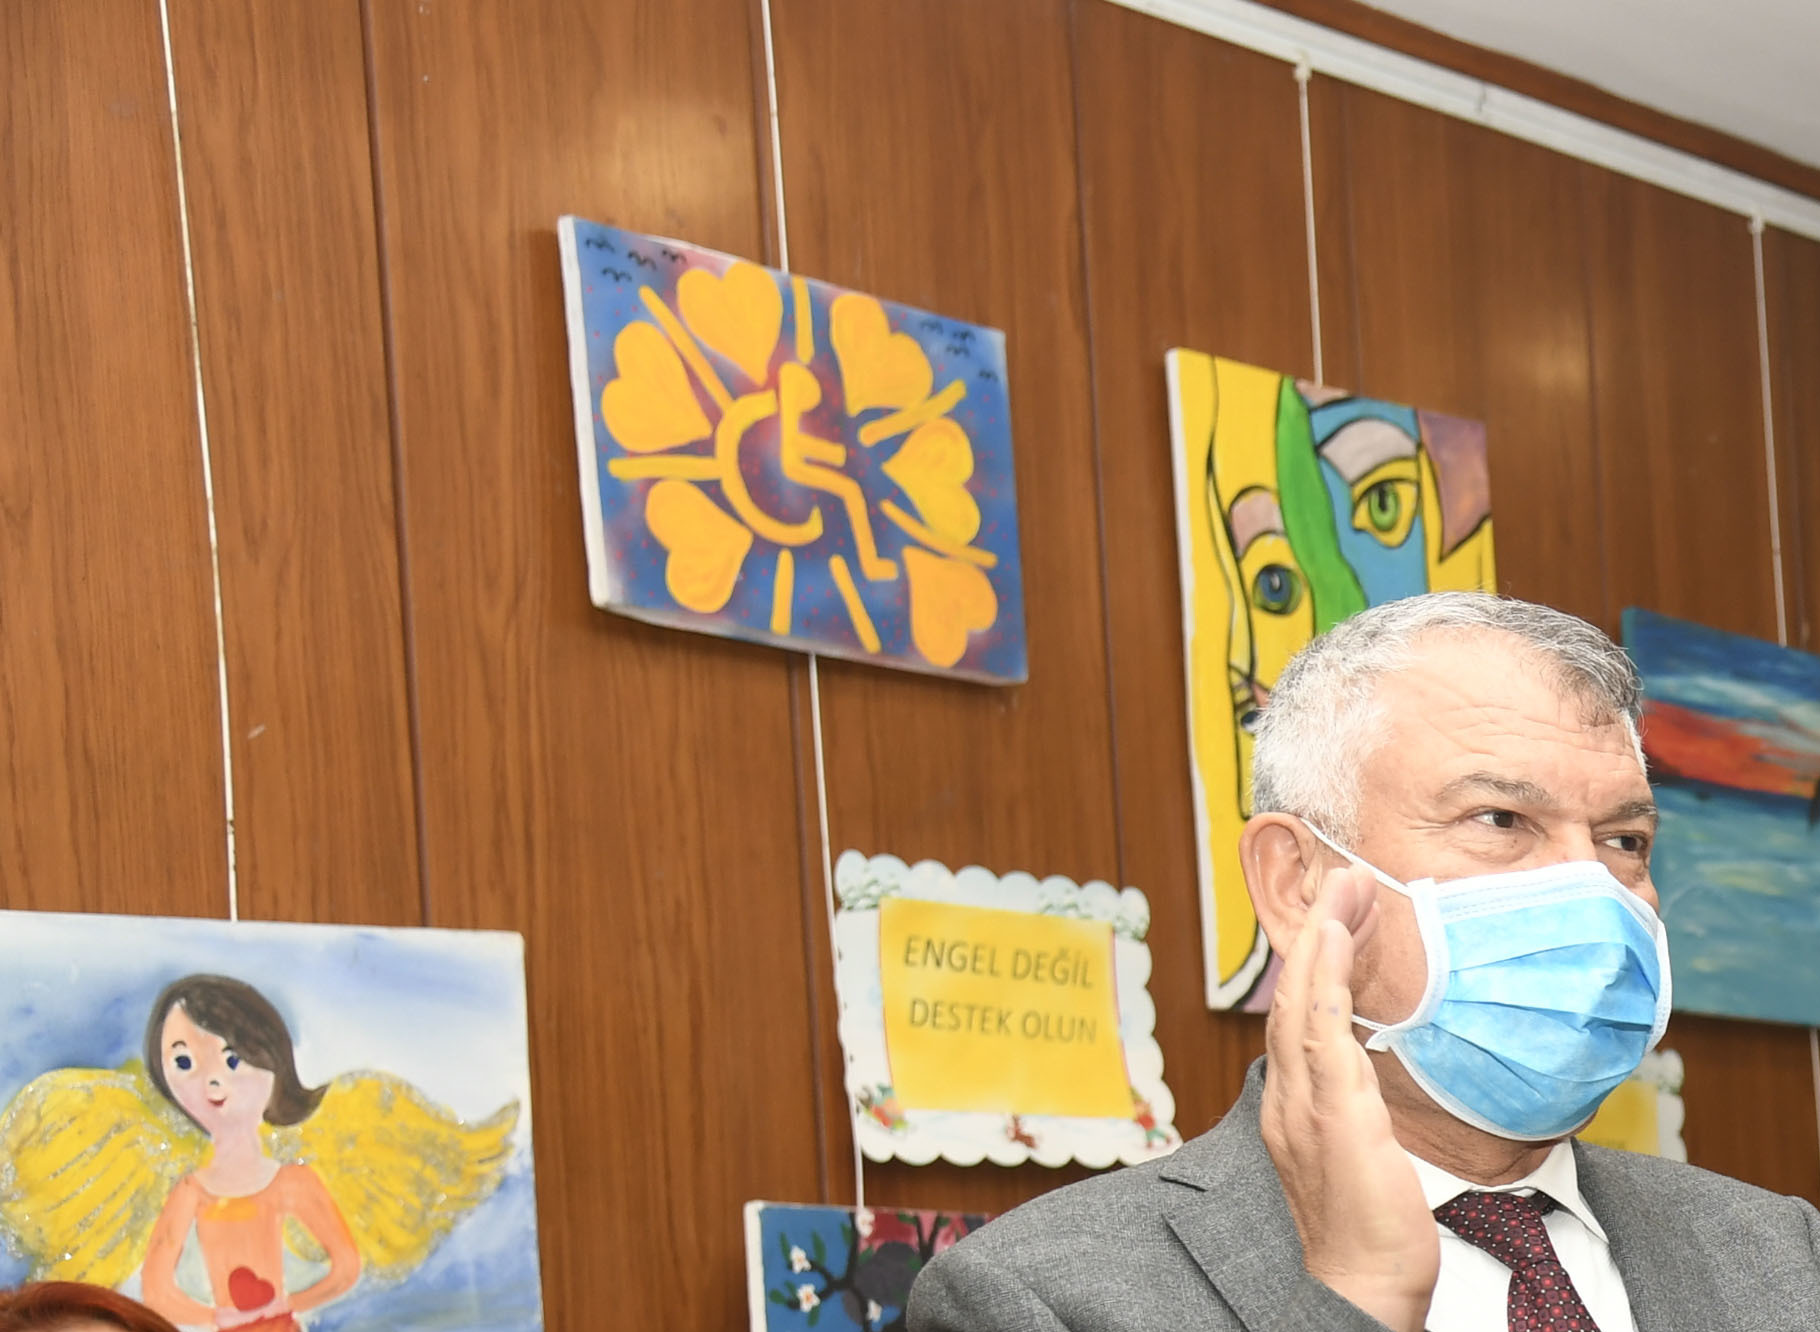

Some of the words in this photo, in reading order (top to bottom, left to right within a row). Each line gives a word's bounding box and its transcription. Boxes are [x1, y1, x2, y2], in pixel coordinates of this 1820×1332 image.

[903, 935, 1000, 977] ENGEL
[1011, 948, 1093, 988] DEĞİL
[909, 998, 1011, 1036] DESTEK
[1021, 1010, 1097, 1044] OLUN
